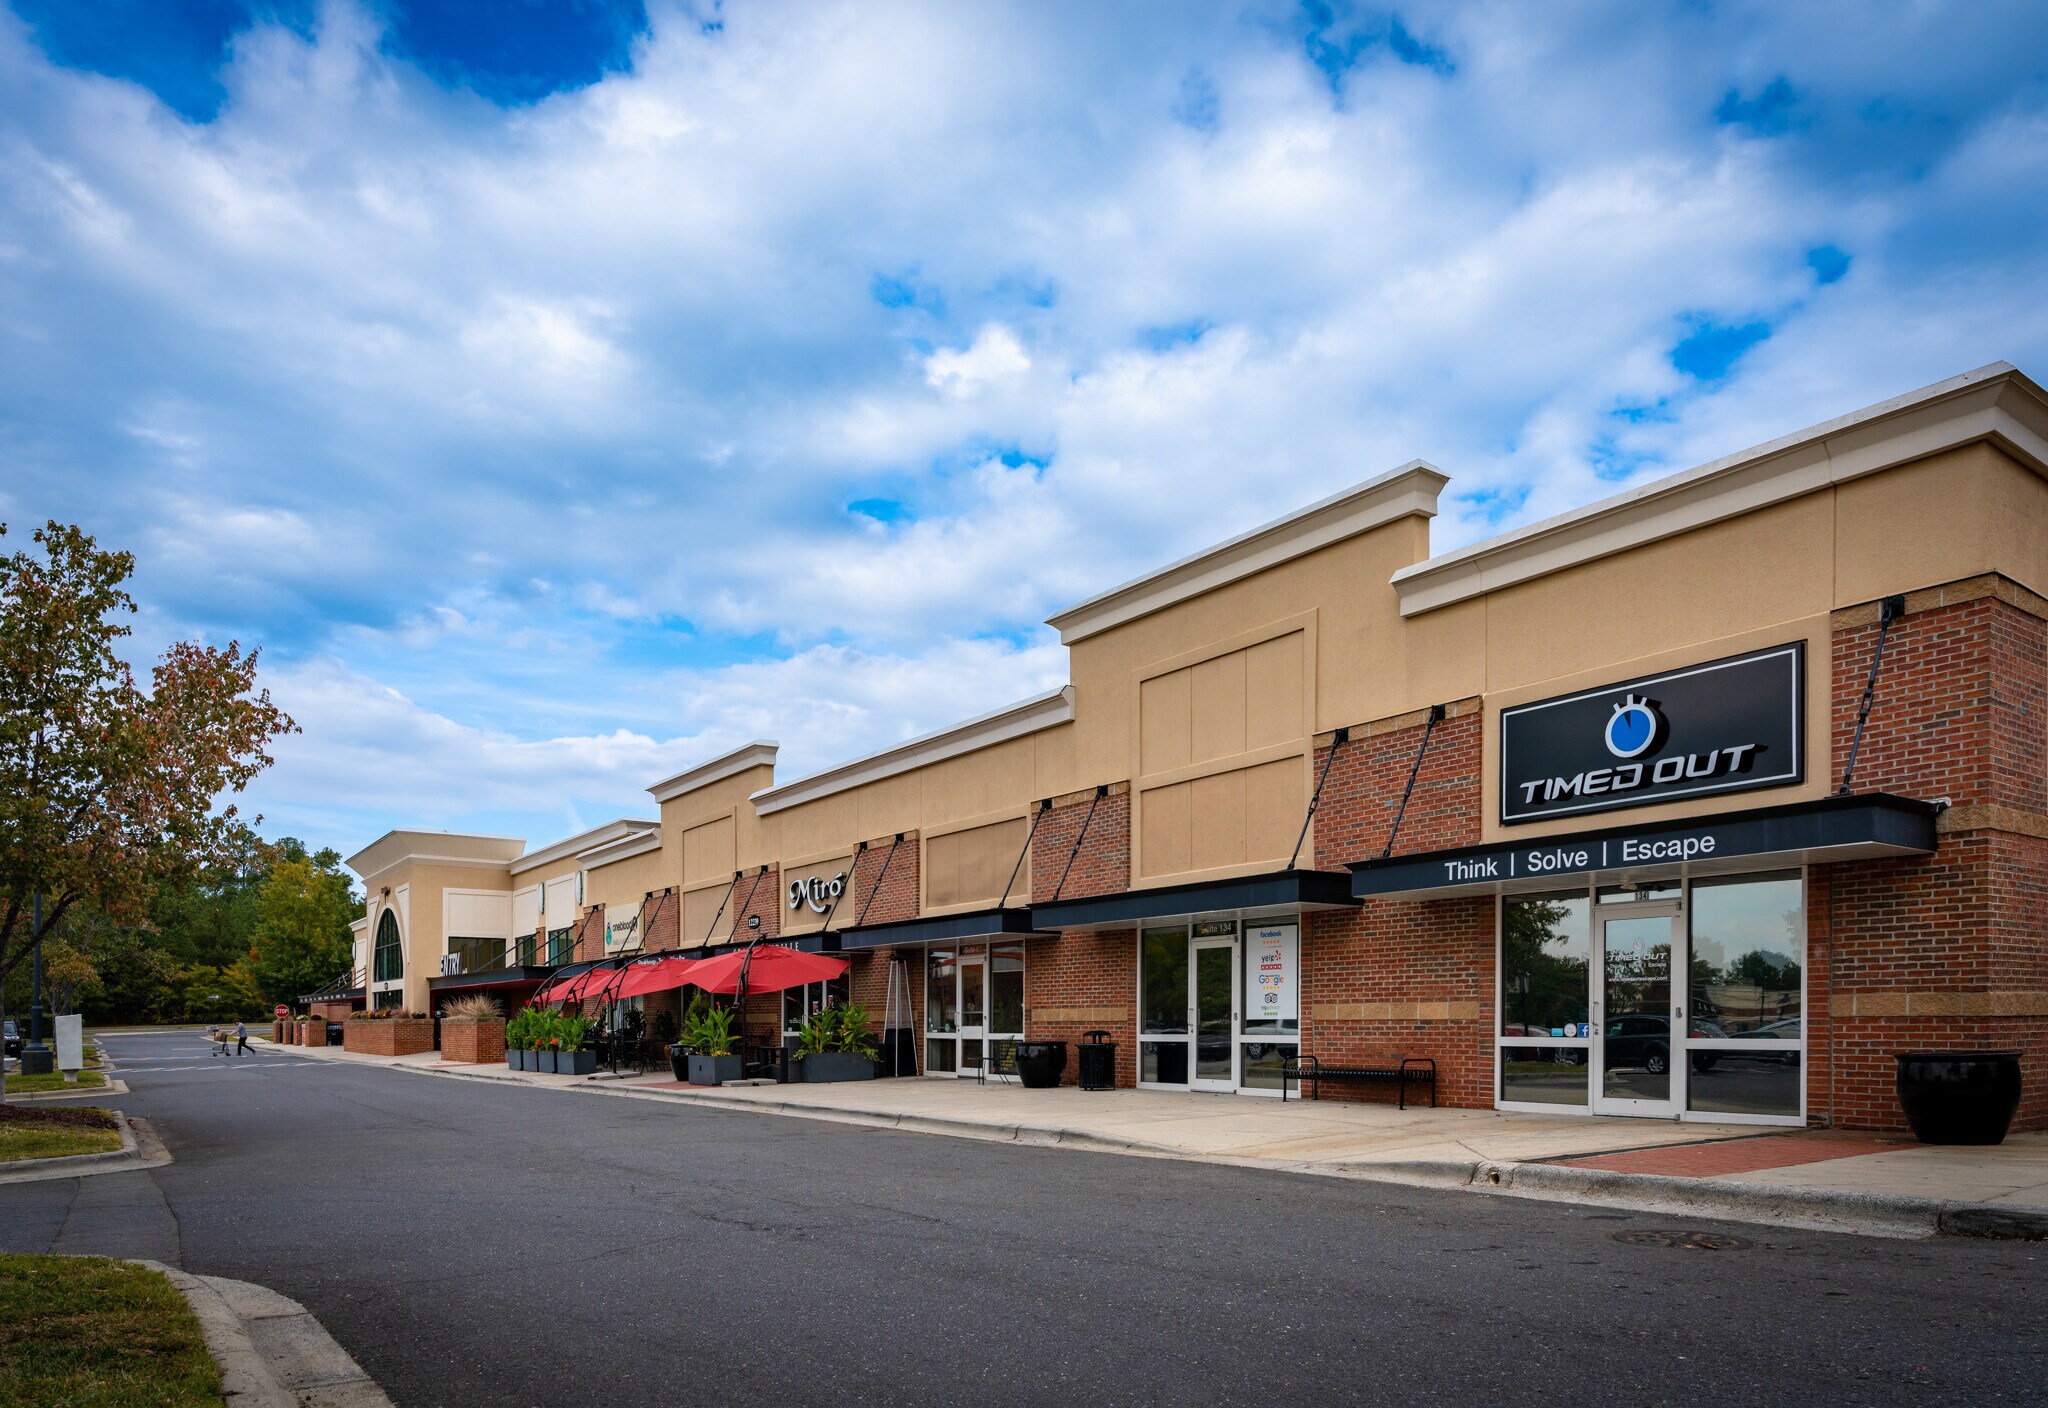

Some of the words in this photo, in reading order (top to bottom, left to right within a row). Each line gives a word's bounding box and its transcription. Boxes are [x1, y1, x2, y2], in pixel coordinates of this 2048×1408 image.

[1519, 763, 1644, 804] TIMED
[1652, 743, 1757, 784] OUT
[1444, 857, 1498, 881] Think
[1527, 848, 1589, 873] Solve
[1622, 834, 1717, 861] Escape
[789, 872, 845, 913] Miró
[1260, 930, 1282, 938] facebook
[440, 952, 461, 977] ENTRY
[1261, 953, 1275, 963] yelp
[1643, 952, 1668, 960] OUT
[1258, 974, 1284, 986] Google
